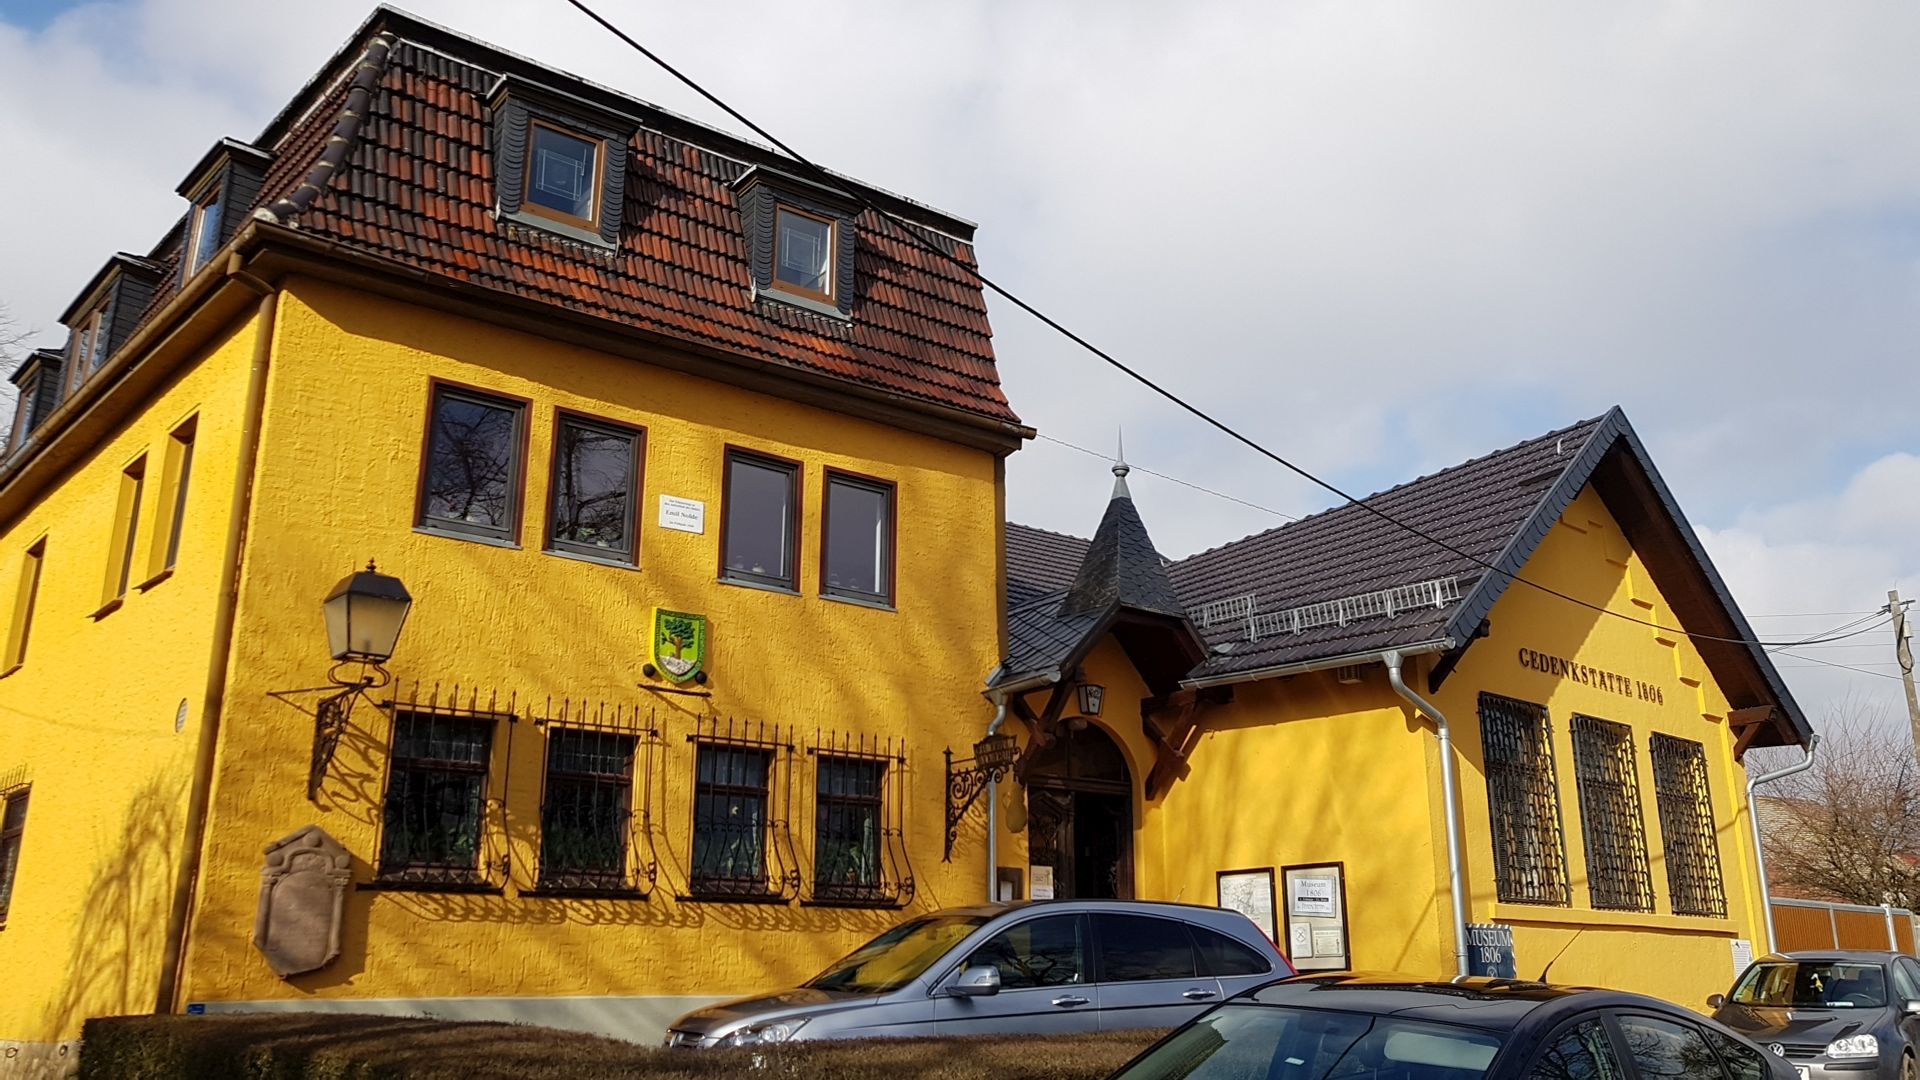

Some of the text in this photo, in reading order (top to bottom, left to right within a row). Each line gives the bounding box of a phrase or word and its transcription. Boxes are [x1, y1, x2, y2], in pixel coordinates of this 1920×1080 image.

[1635, 680, 1664, 706] 1806
[1299, 880, 1326, 888] Museum
[1306, 889, 1322, 897] 1806
[1465, 929, 1511, 947] MUSEUM
[1480, 946, 1502, 963] 1806
